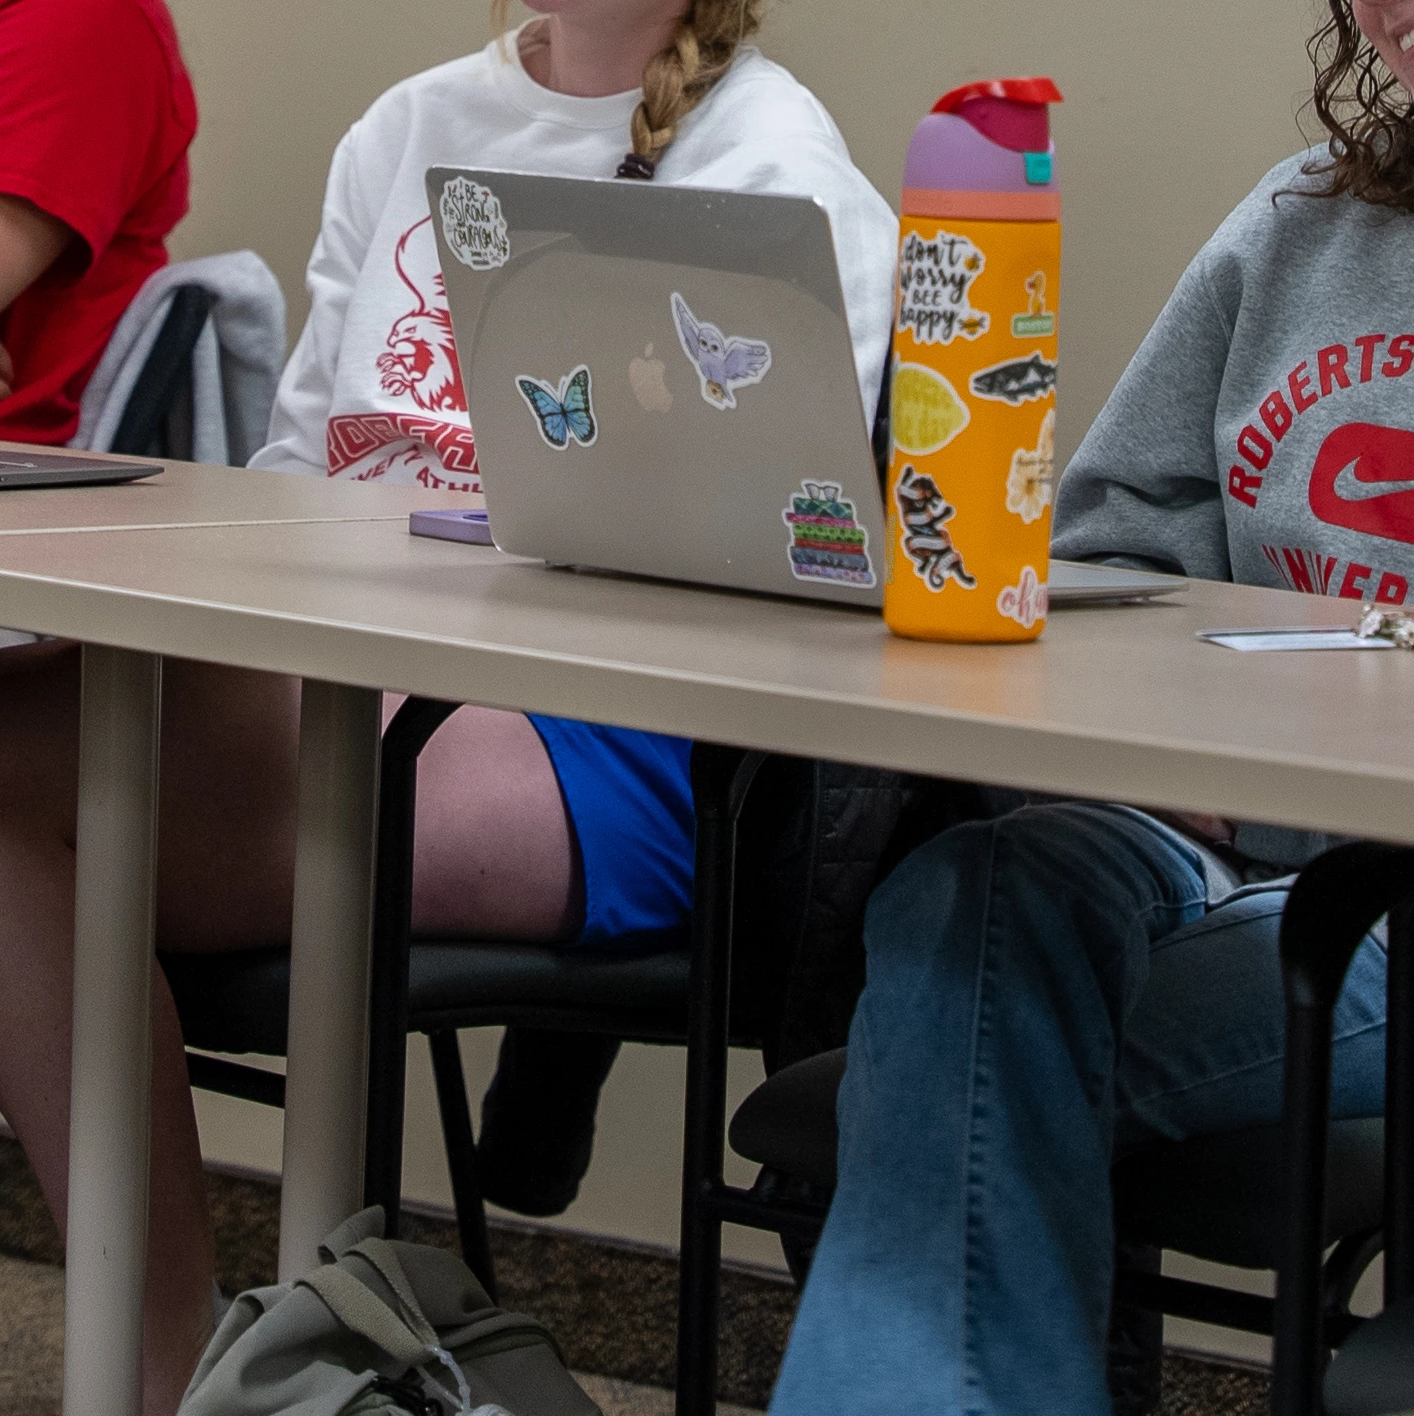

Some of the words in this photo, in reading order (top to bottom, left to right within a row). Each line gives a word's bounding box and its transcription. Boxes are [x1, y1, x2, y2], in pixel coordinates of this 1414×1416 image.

[464, 184, 479, 203] BE
[452, 193, 491, 224] STRONG
[912, 288, 942, 307] BEE
